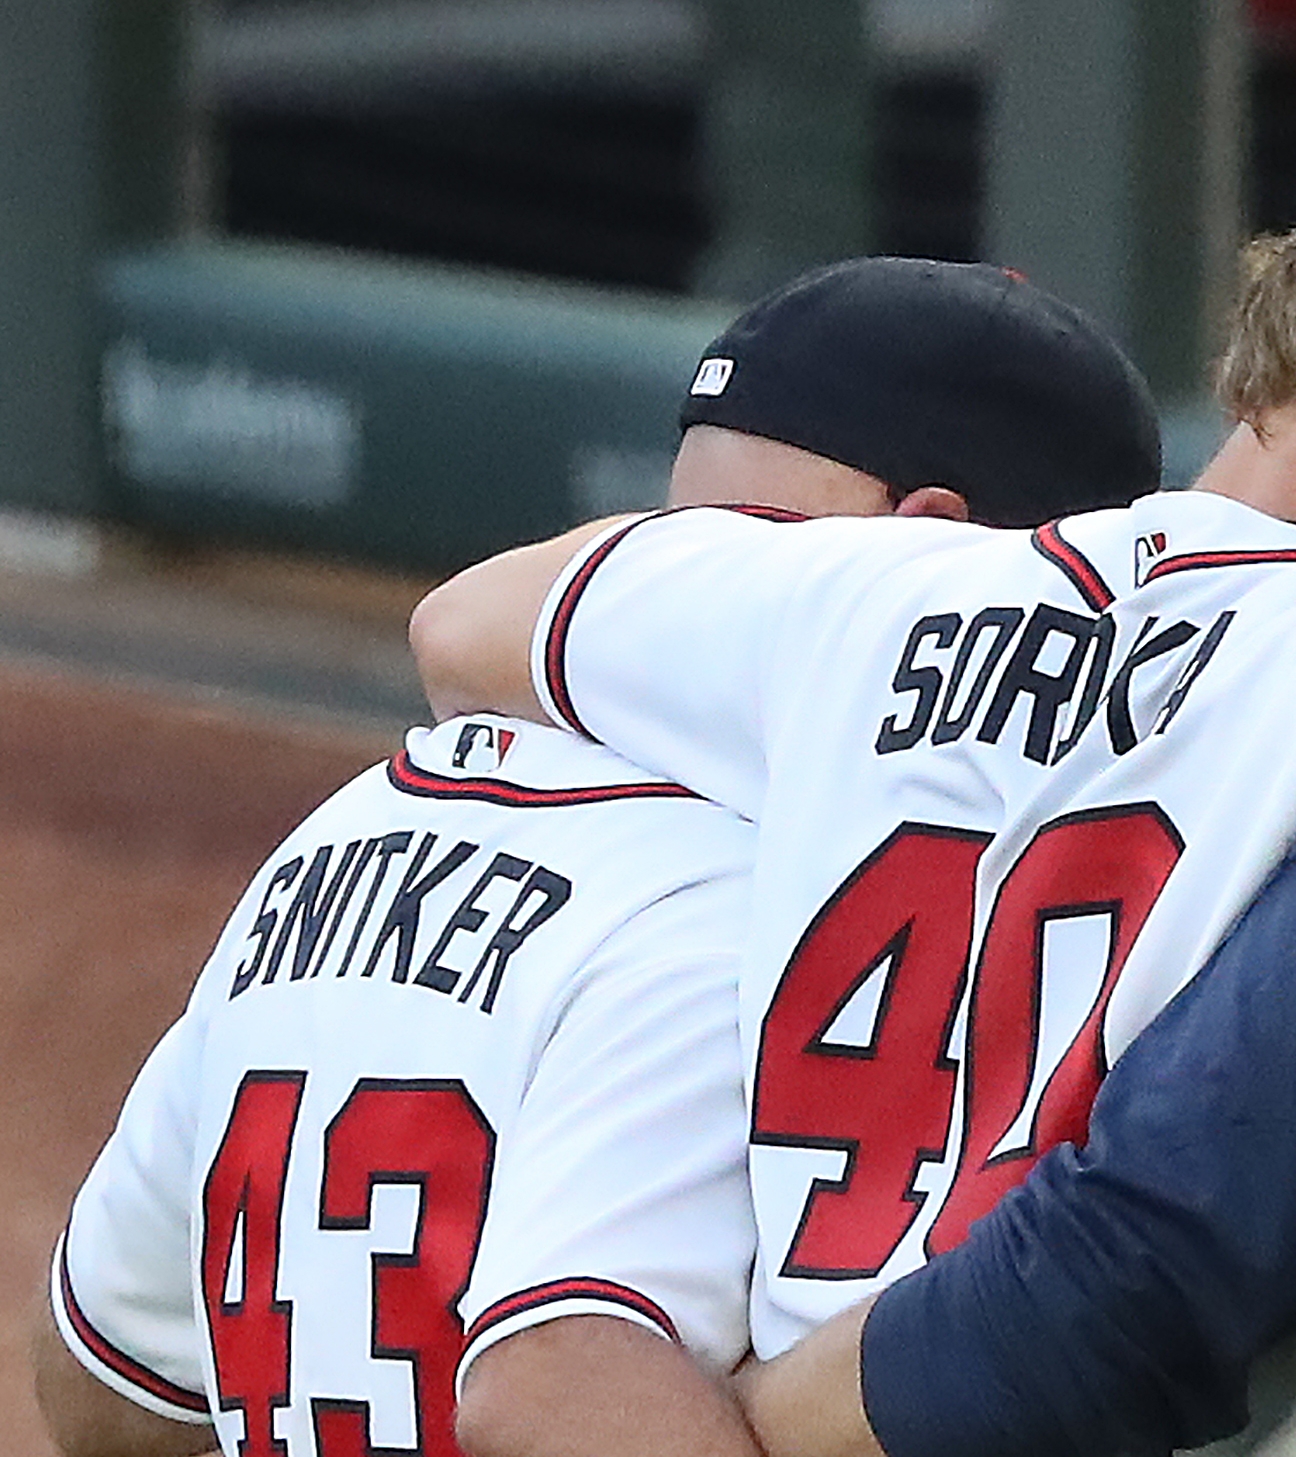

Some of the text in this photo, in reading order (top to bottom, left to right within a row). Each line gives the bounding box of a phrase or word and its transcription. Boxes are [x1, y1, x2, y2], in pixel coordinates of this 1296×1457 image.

[229, 830, 573, 1015] SNITKER
[749, 801, 1186, 1279] 40
[201, 1069, 498, 1457] 43
